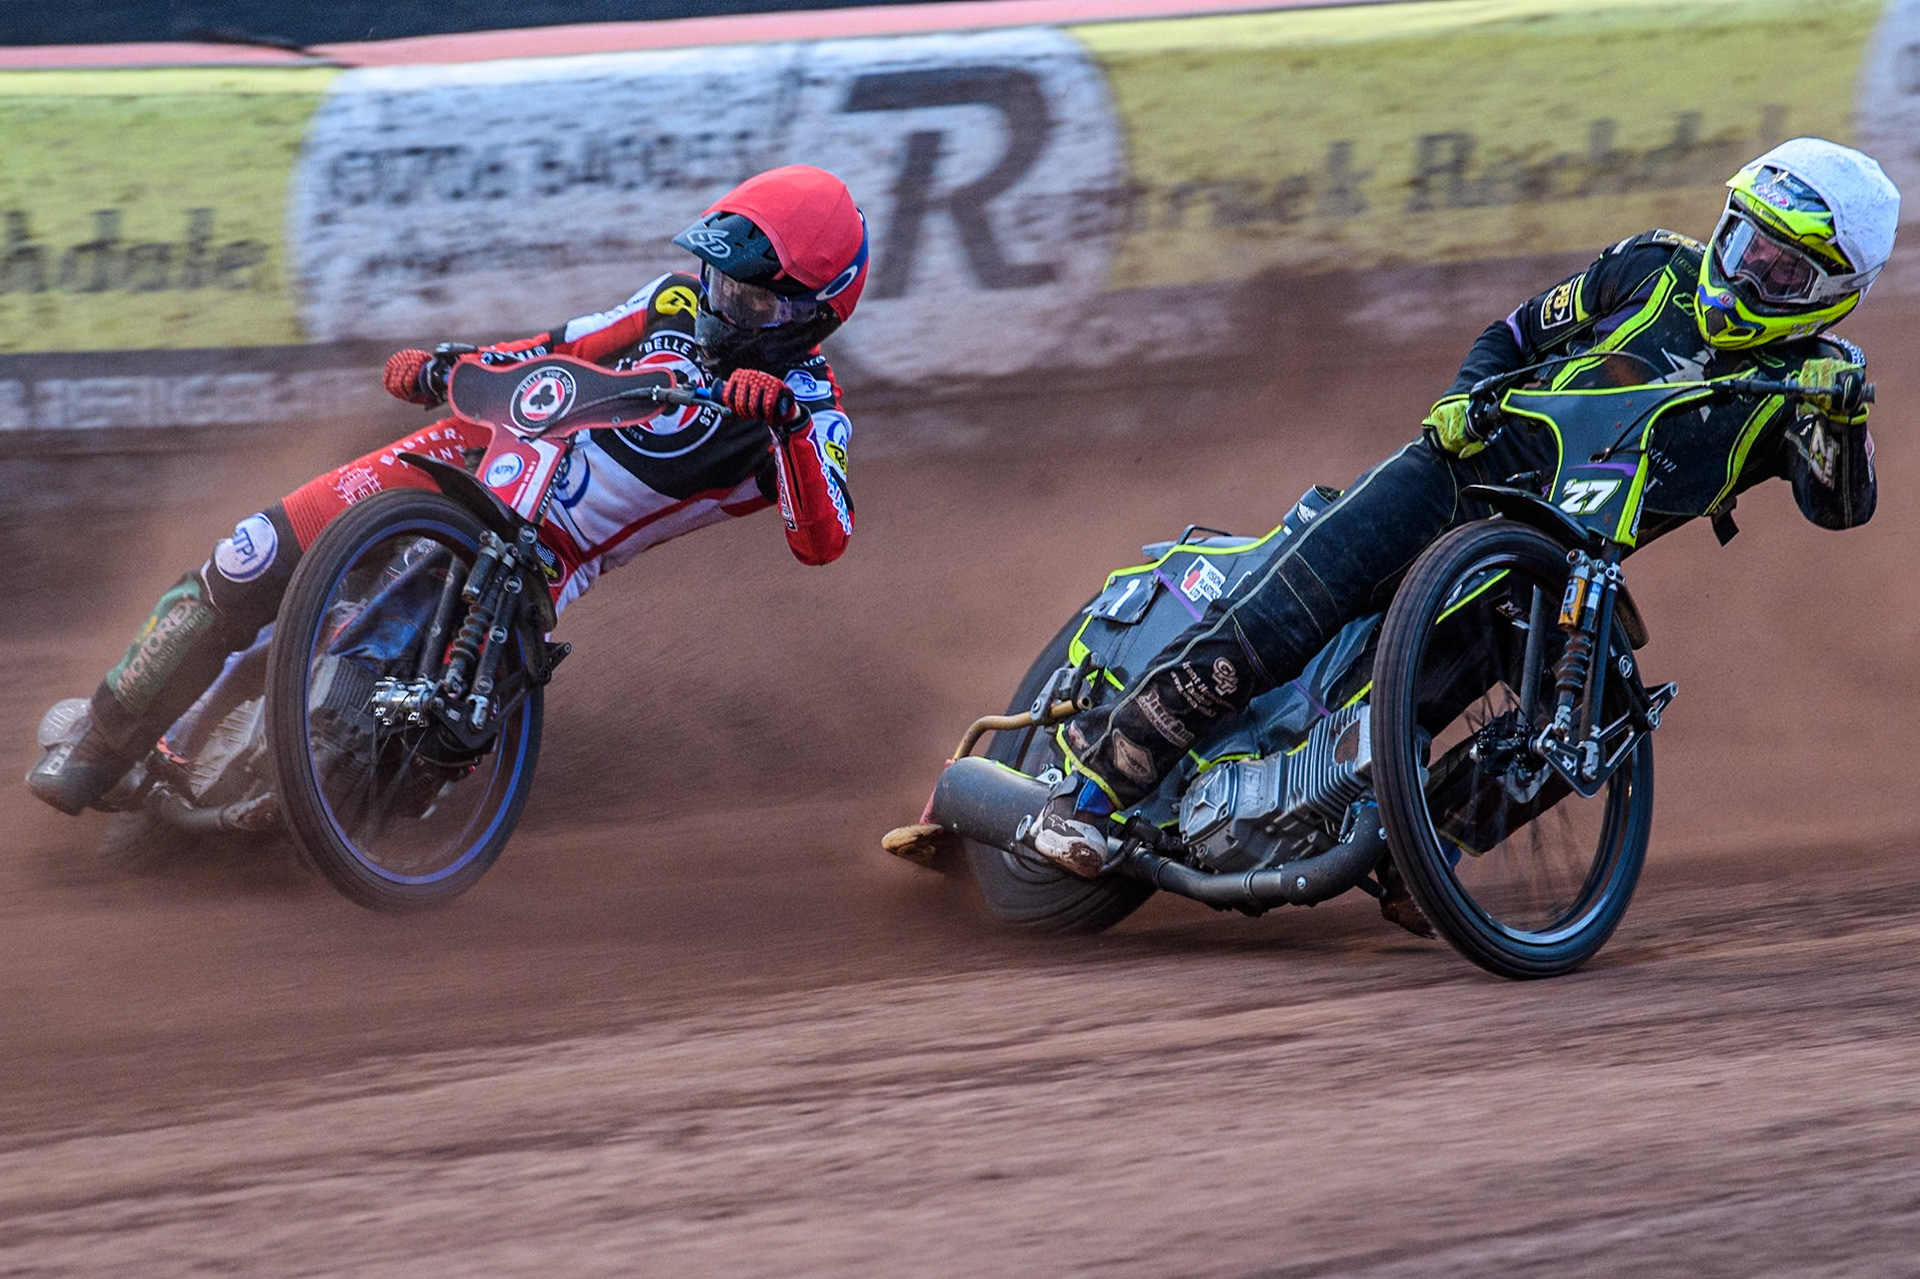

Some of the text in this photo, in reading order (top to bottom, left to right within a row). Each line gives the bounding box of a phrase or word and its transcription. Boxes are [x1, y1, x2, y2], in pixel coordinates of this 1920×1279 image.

[838, 66, 1060, 298] R
[1559, 479, 1622, 515] 27
[1107, 578, 1141, 617] 1
